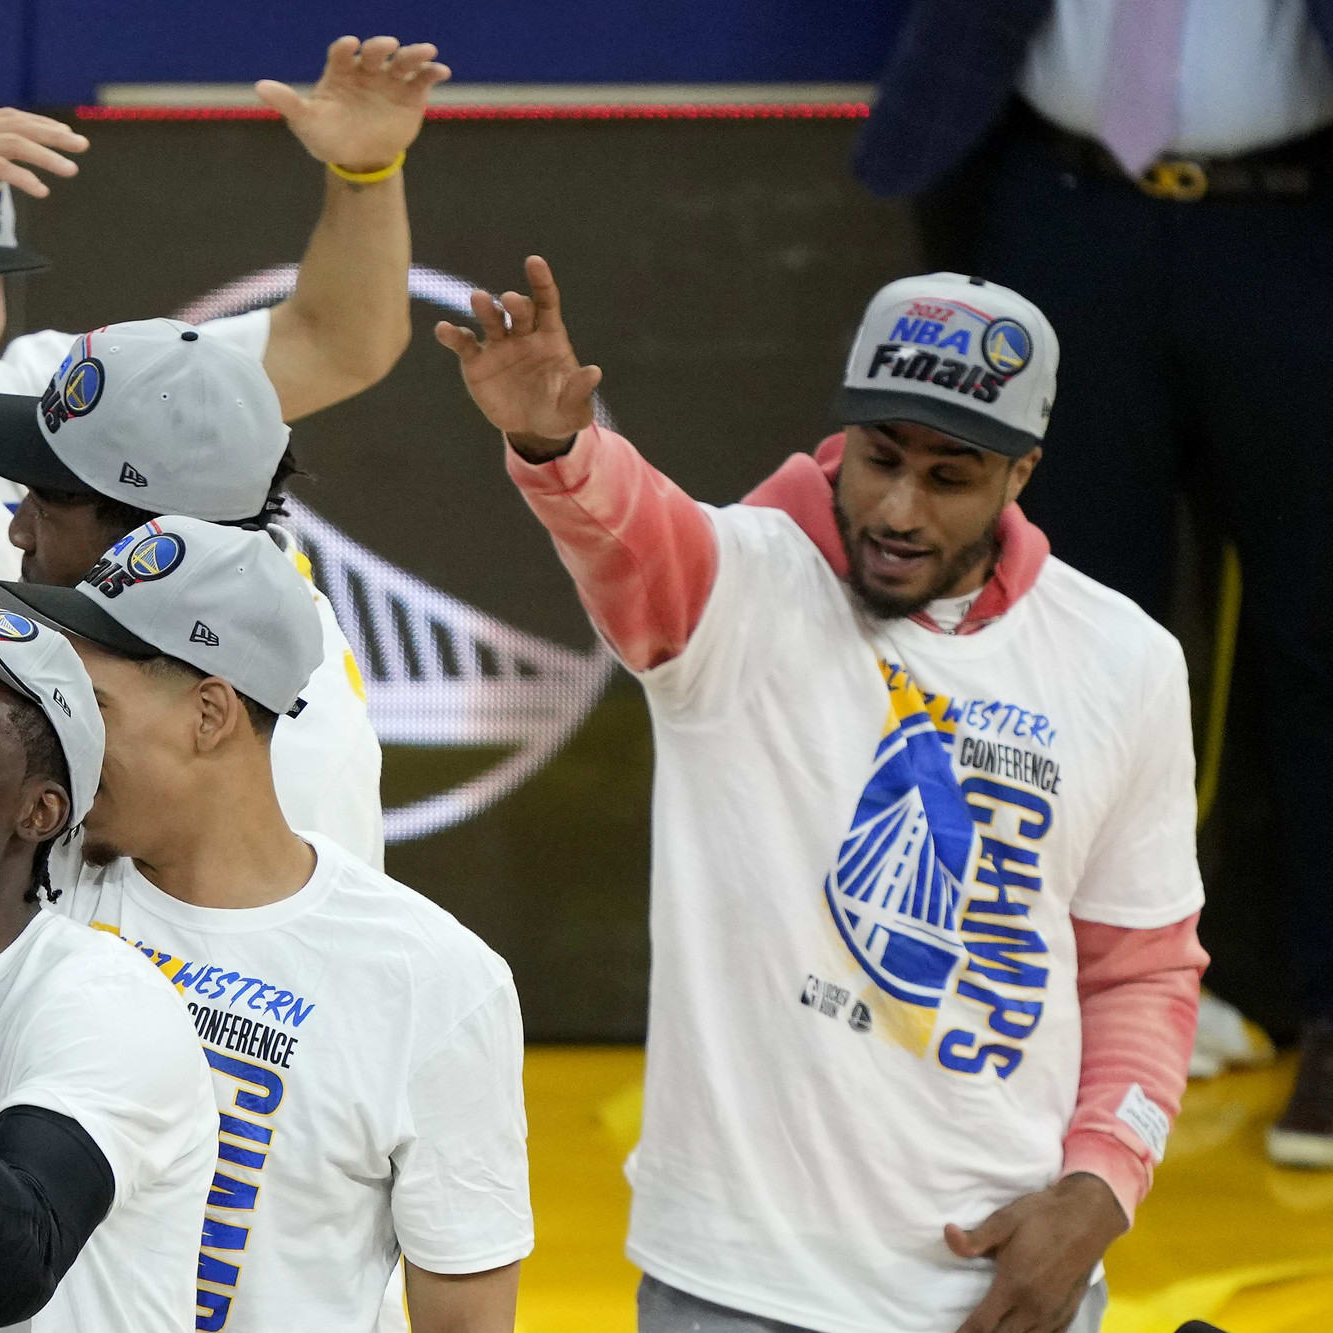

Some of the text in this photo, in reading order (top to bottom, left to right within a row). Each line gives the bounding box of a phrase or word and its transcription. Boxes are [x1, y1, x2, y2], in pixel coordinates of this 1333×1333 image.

[889, 316, 971, 355] NBA
[906, 301, 955, 323] 2022
[867, 343, 1007, 404] Finals
[959, 736, 1062, 795] CONFERENCE
[937, 775, 1054, 1081] CHAMPS
[171, 961, 316, 1028] WESTERN
